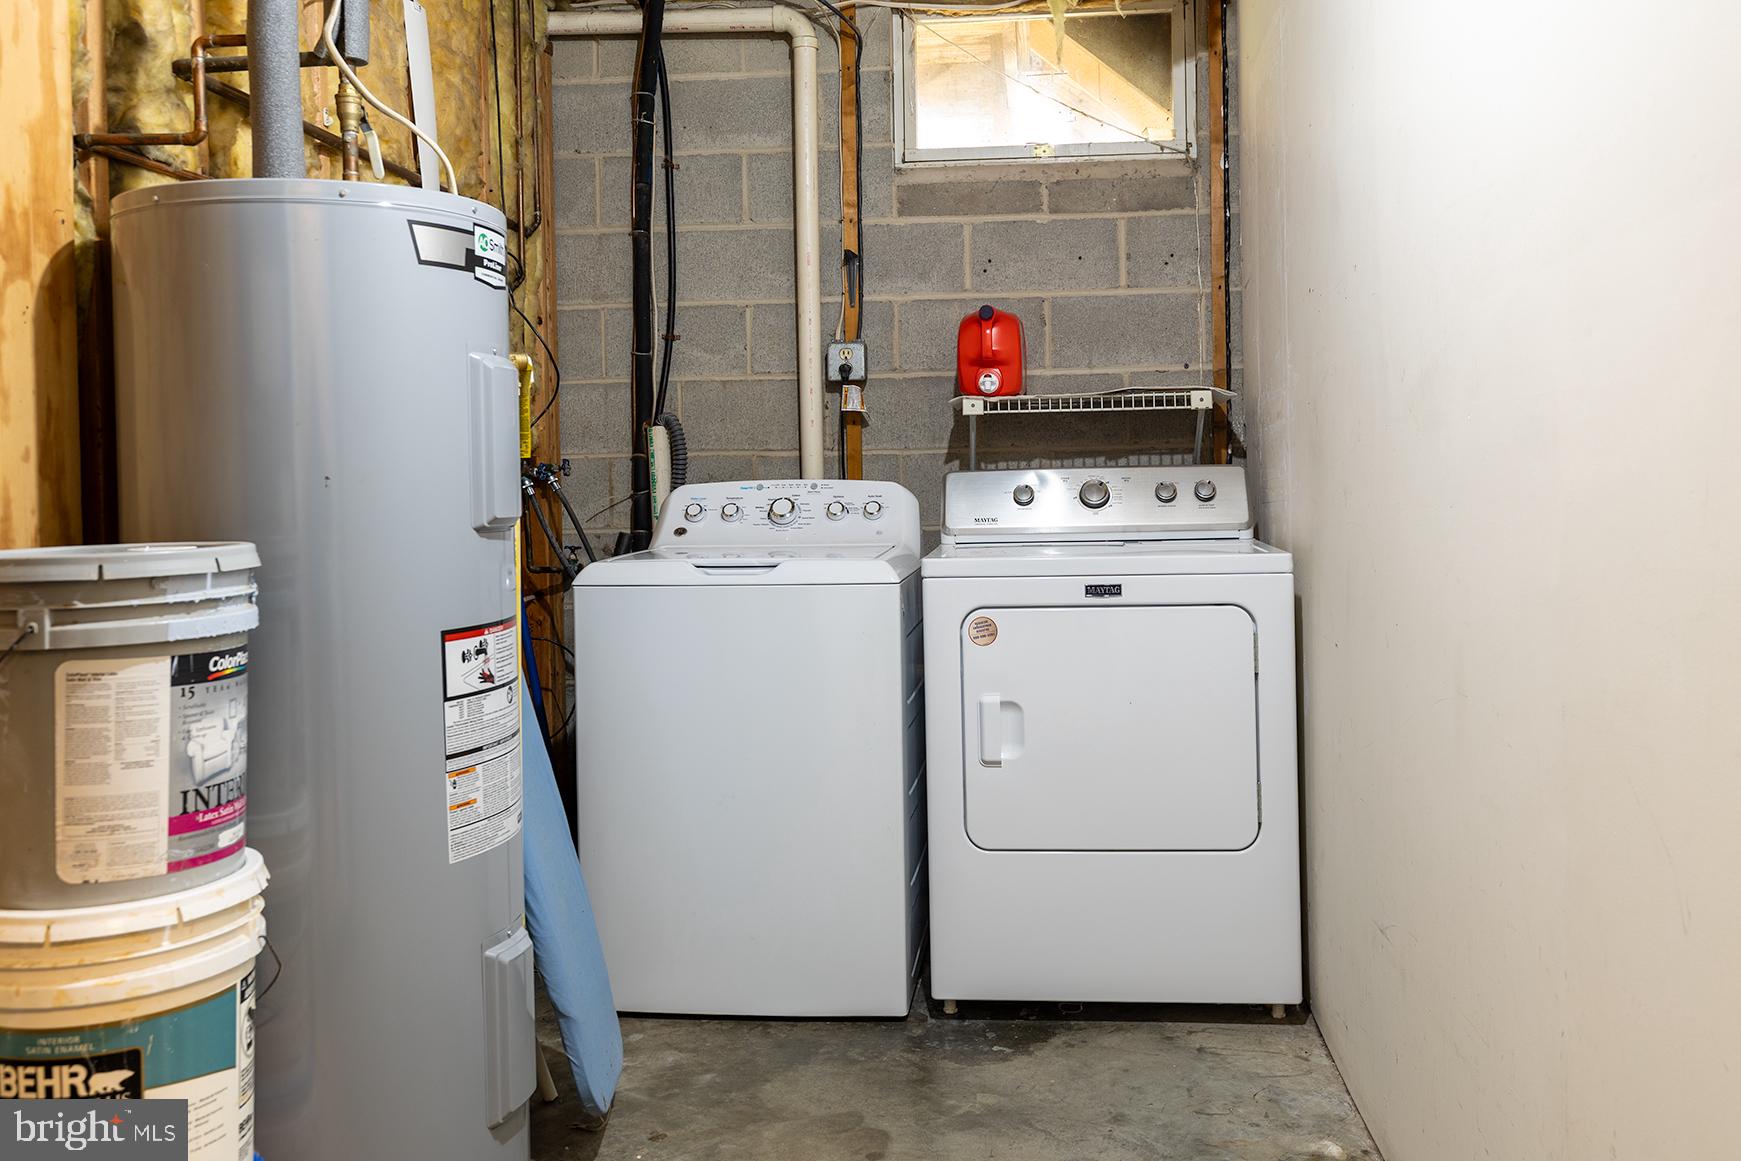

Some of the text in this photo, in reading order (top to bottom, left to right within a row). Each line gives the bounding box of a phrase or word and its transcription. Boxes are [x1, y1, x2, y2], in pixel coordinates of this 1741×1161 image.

[1087, 586, 1120, 594] MAYTAG
[180, 686, 196, 700] 15
[0, 1063, 89, 1099] BEHR
